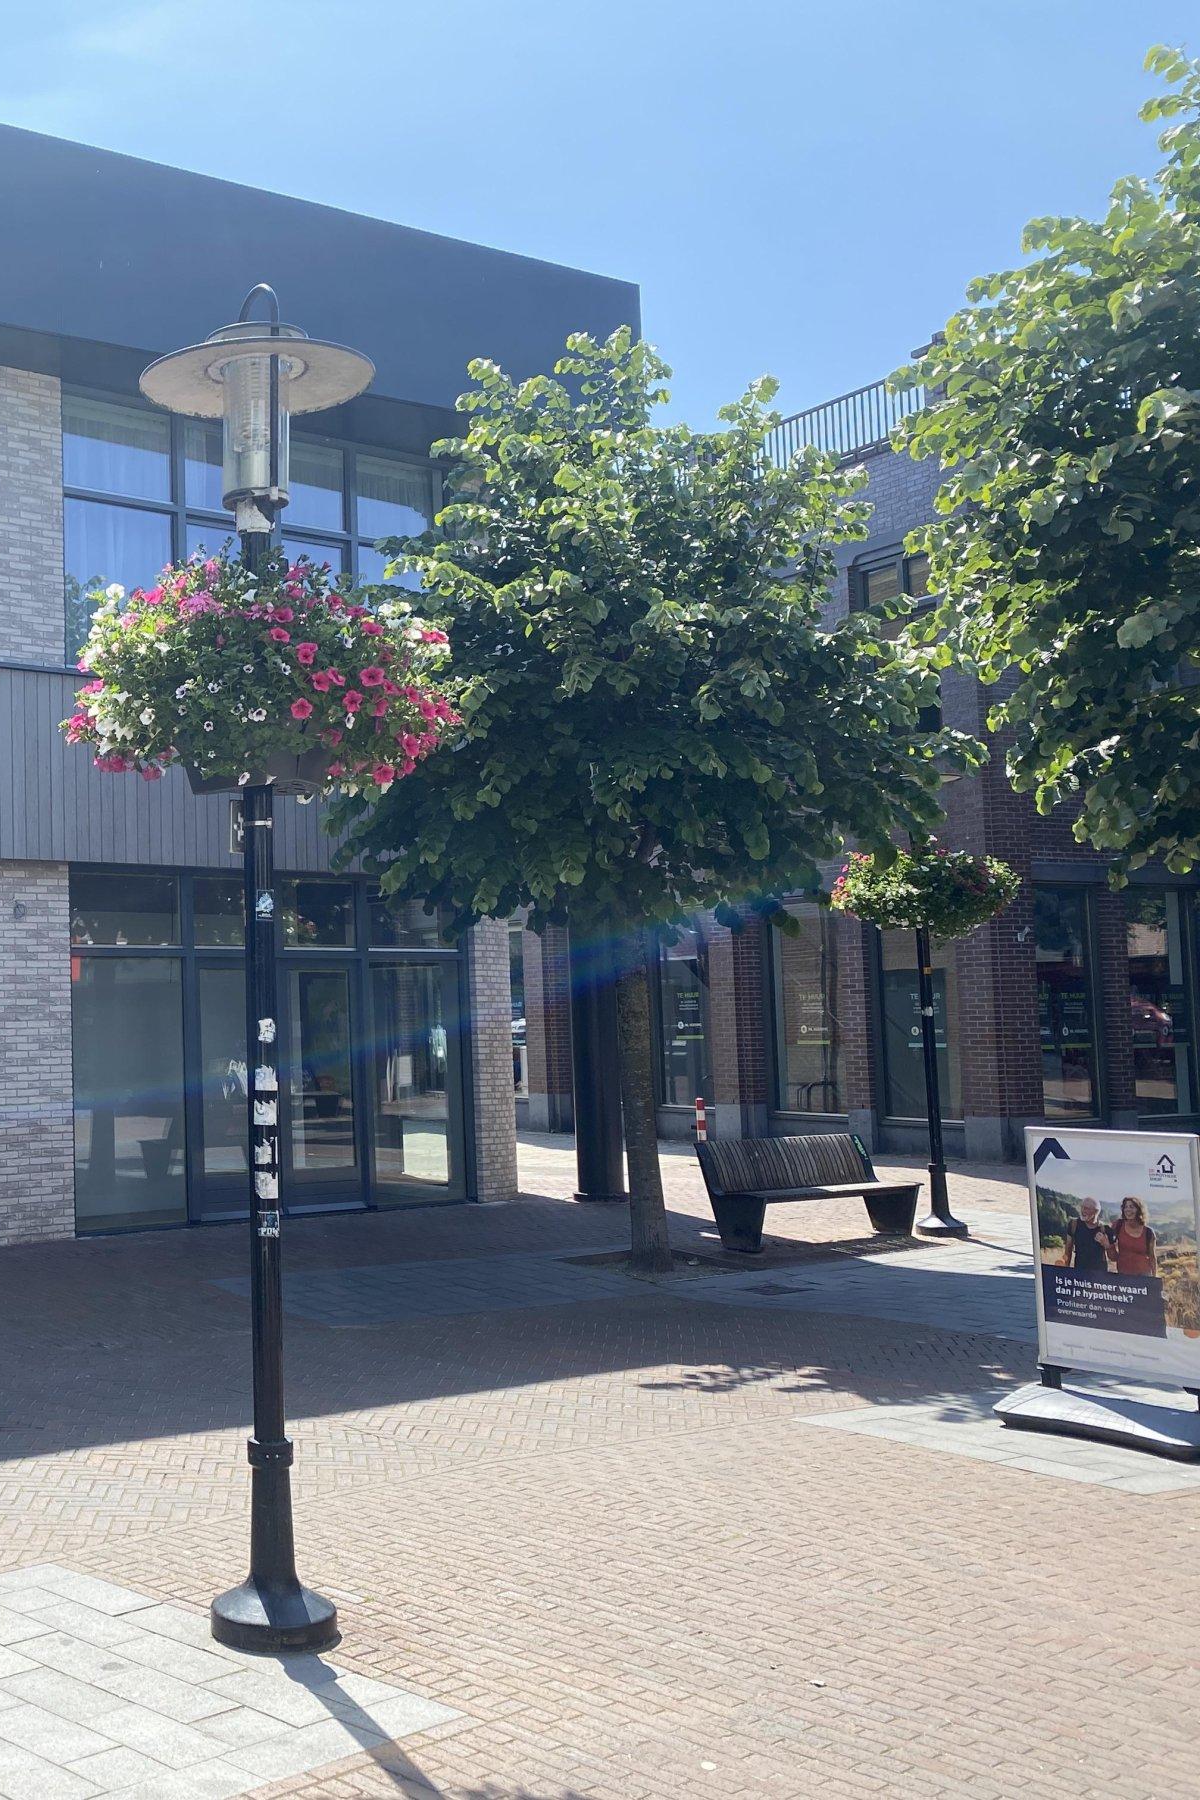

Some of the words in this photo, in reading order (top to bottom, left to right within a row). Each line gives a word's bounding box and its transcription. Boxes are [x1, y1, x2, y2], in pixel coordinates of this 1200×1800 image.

[1055, 1276, 1063, 1285] Is
[1064, 1277, 1072, 1287] je
[1074, 1278, 1092, 1289] huis
[1093, 1282, 1117, 1292] meer
[1119, 1285, 1147, 1295] waard
[1055, 1286, 1071, 1295] dan
[1072, 1287, 1081, 1298] je
[1083, 1289, 1134, 1303] hypotheek?
[1057, 1298, 1087, 1309] Profiteer
[1057, 1308, 1097, 1319] overwaarde
